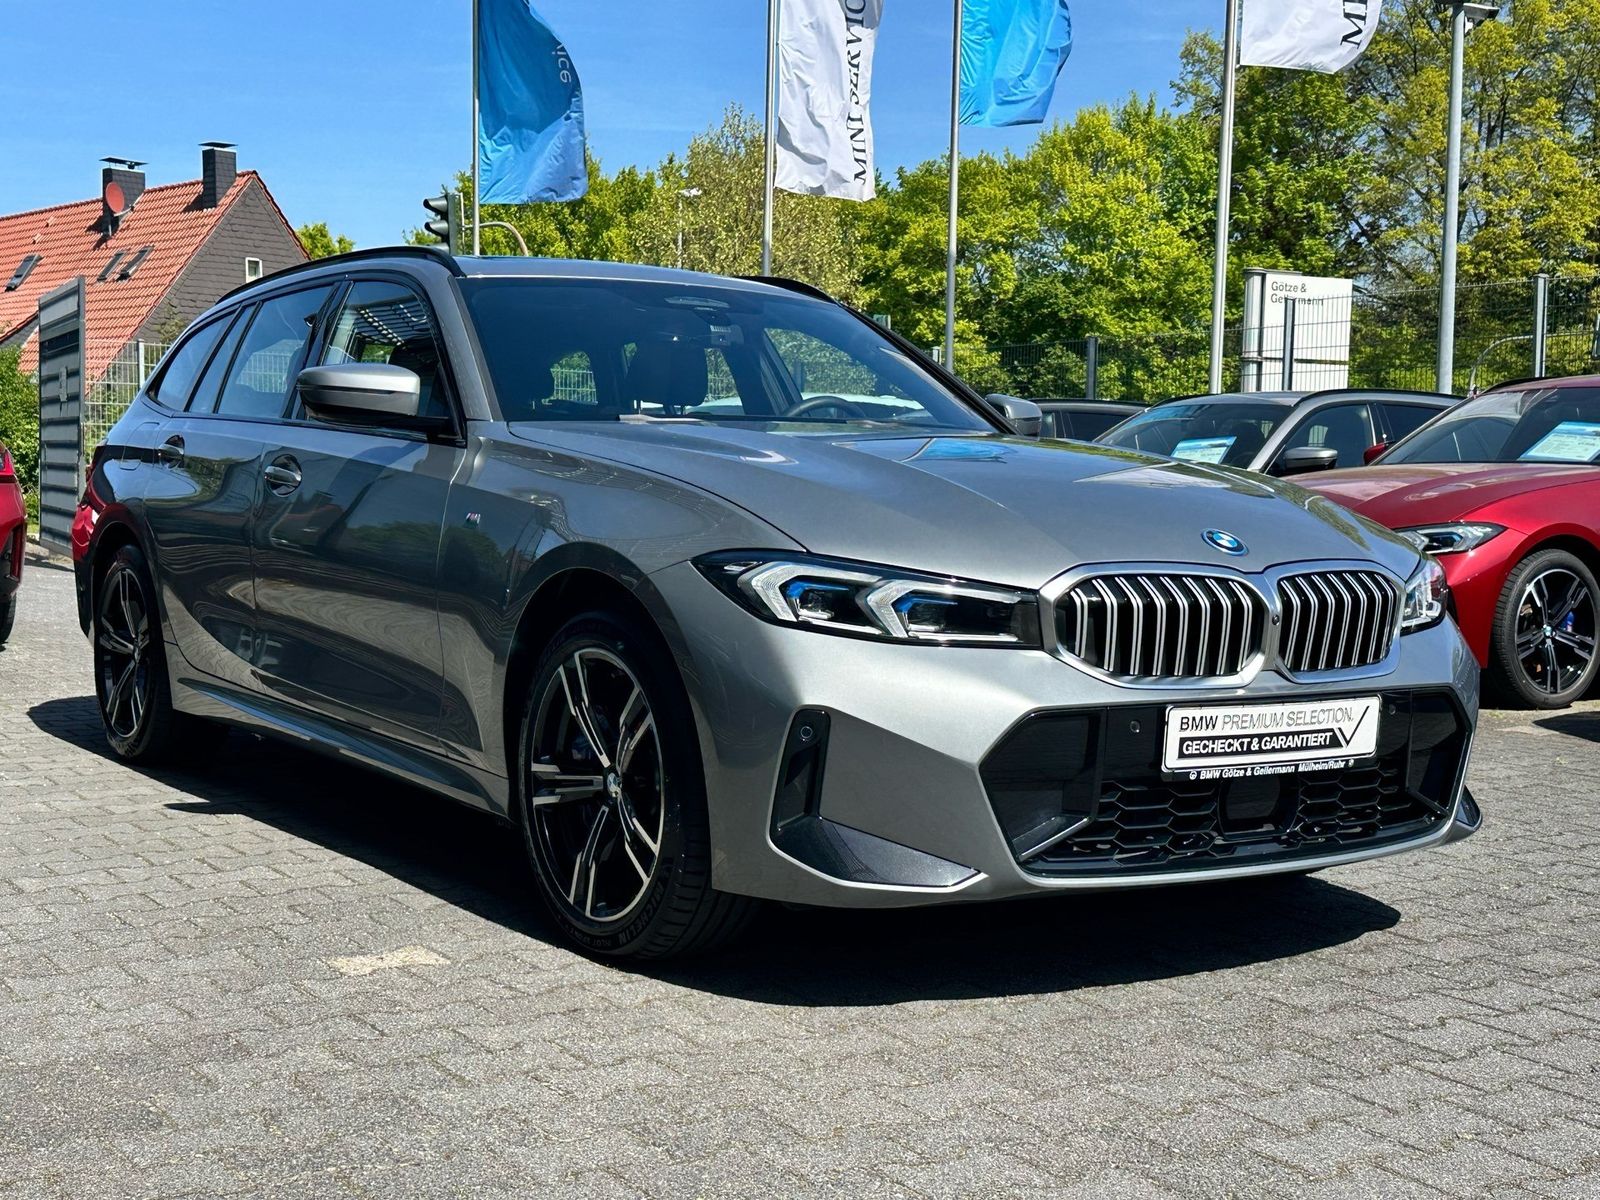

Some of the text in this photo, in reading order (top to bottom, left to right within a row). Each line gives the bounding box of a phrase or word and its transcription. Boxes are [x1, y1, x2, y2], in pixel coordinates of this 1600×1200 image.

[846, 112, 867, 185] MINI
[1271, 281, 1307, 292] Götze &
[1179, 715, 1218, 732] BMW
[1222, 712, 1284, 730] PREMIUM
[1182, 732, 1333, 755] GECHECKT & GARANTIERT
[1200, 760, 1346, 780] BMW Götze & Gellermann Mülheim/Ruhr
[618, 880, 665, 945] MICHELIN
